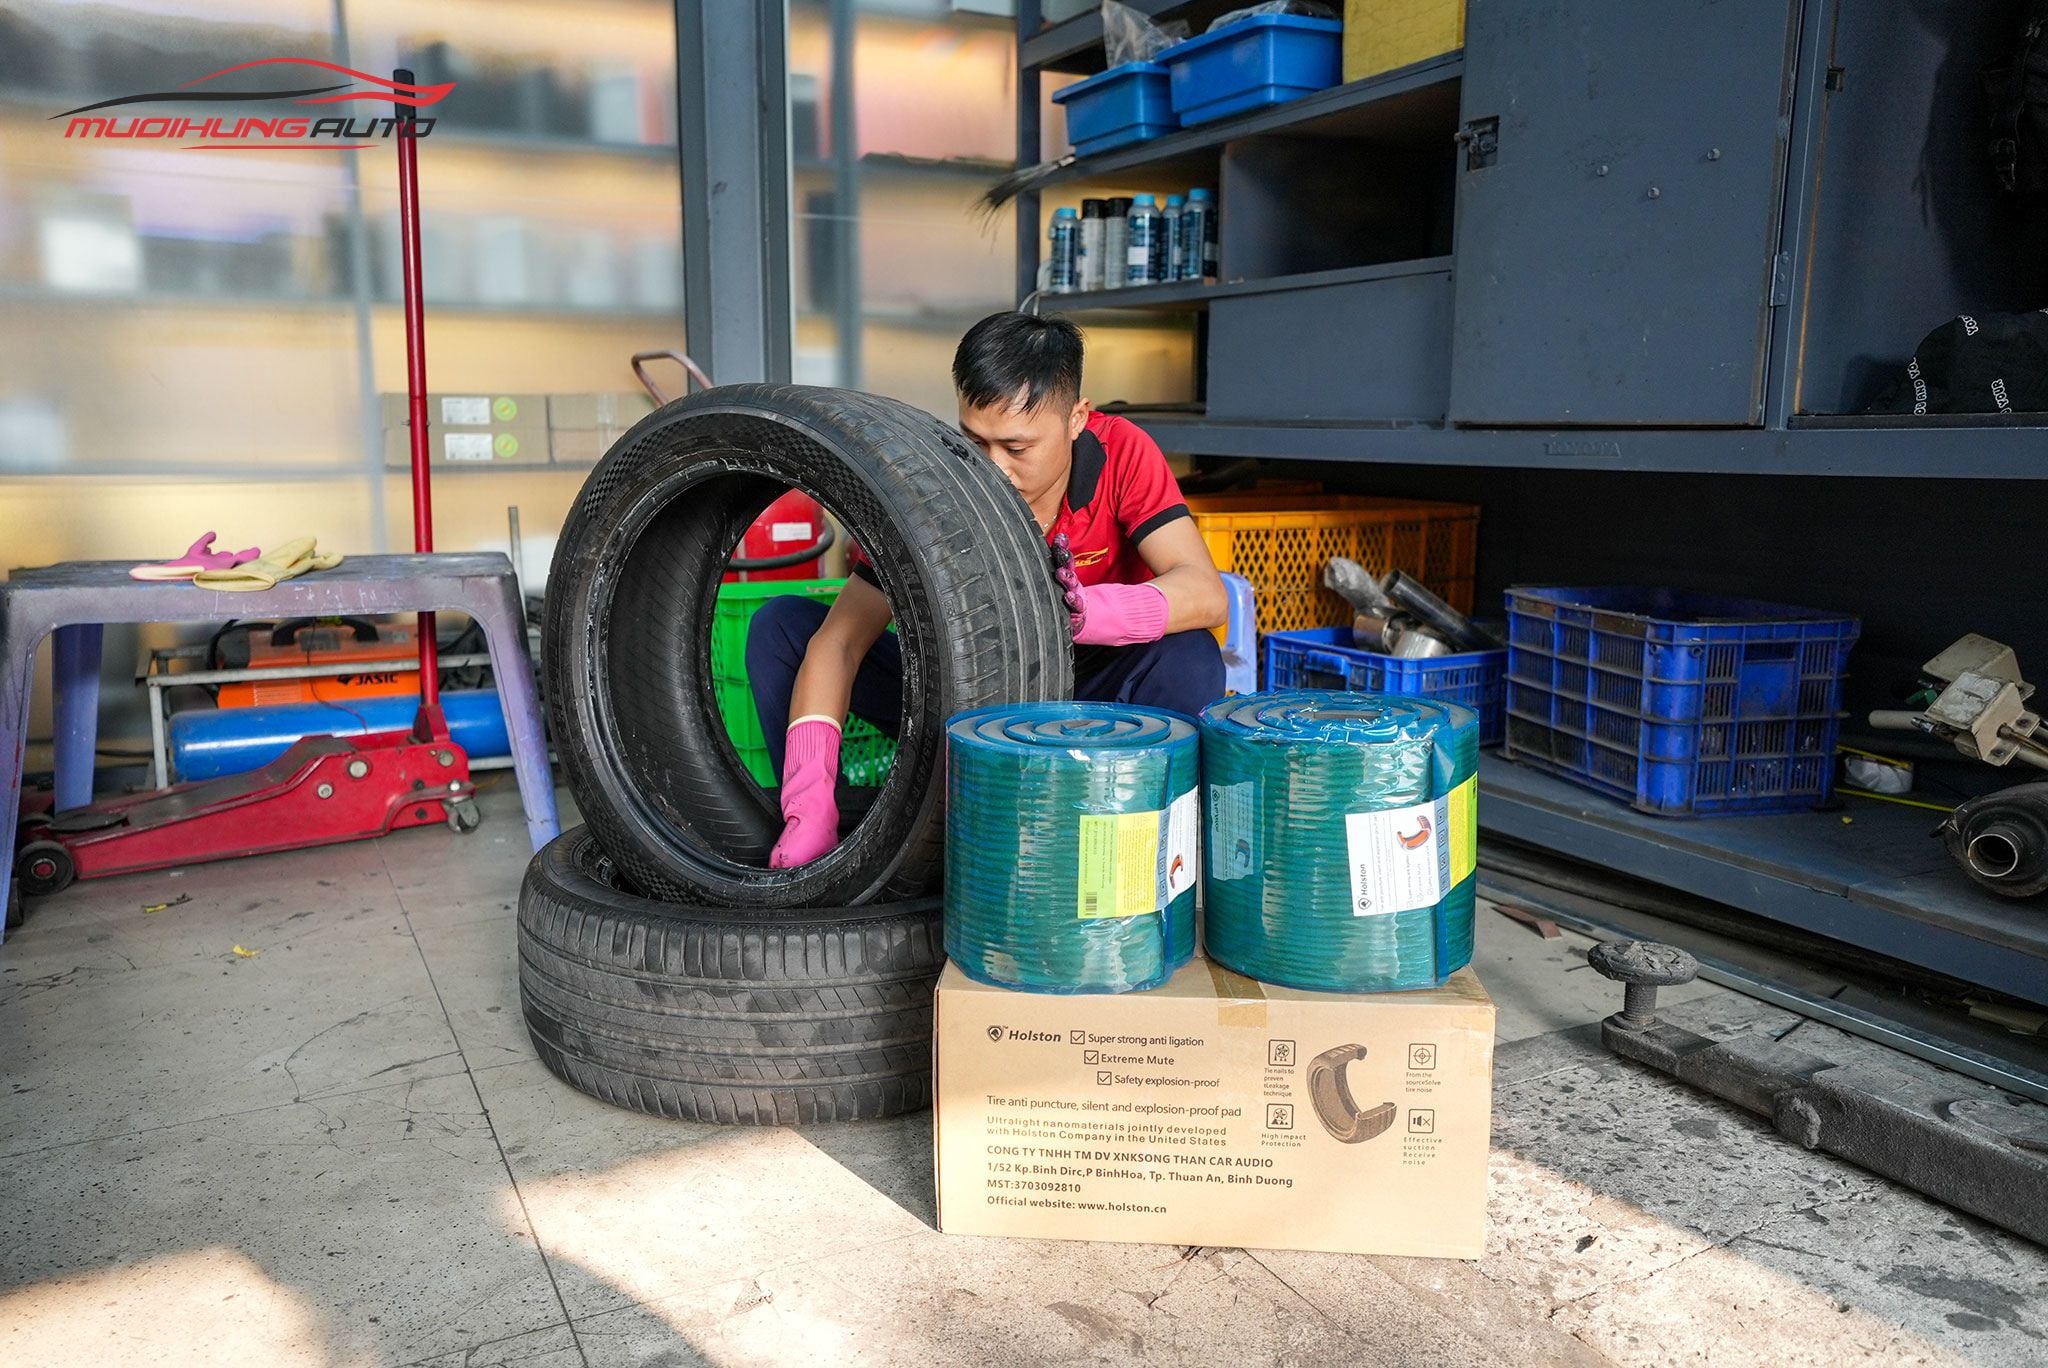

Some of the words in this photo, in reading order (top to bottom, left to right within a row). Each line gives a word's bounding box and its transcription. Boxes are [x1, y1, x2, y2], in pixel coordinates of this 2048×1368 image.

[1958, 315, 1979, 336] YOU
[1914, 379, 1927, 401] AND
[1991, 378, 2009, 409] YOUR
[355, 673, 399, 685] JASIC
[1360, 864, 1368, 895] Holston
[1008, 1030, 1062, 1042] Holston
[1088, 1033, 1116, 1048] Super
[1117, 1035, 1147, 1047] strong
[1149, 1036, 1167, 1046] anti
[1169, 1036, 1204, 1048] ligation
[1101, 1054, 1144, 1064] Extreme
[1146, 1056, 1175, 1065] Mute
[1114, 1075, 1144, 1086] Safety
[1145, 1076, 1220, 1088] explosion-proof
[987, 1095, 1006, 1106] Tire
[1008, 1096, 1028, 1107] anti
[1030, 1098, 1079, 1111] puncture,
[1082, 1099, 1109, 1112] silent
[1111, 1101, 1132, 1113] and
[1134, 1103, 1219, 1117] explosion-proof
[1221, 1106, 1241, 1118] pad
[987, 1116, 1040, 1128] Ultralight
[1043, 1119, 1125, 1131] nanomaterials
[1127, 1122, 1163, 1135] jointly
[1166, 1125, 1226, 1137] developed
[987, 1126, 1010, 1136] with
[1012, 1128, 1056, 1139] Holston
[1059, 1130, 1111, 1143] Company
[1114, 1133, 1125, 1142] in
[1128, 1133, 1145, 1144] the
[1149, 1134, 1186, 1145] United
[1189, 1136, 1226, 1147] States
[1280, 1133, 1306, 1141] impact
[1403, 1136, 1443, 1144] Effective
[987, 1145, 1019, 1157] CONG
[1022, 1147, 1036, 1157] TY
[1039, 1148, 1071, 1159] TNHH
[1074, 1150, 1092, 1160] TM
[1094, 1151, 1111, 1161] DV
[1113, 1152, 1171, 1164] XNKSONG
[1173, 1154, 1206, 1166] THAN
[1209, 1156, 1233, 1166] CAR
[1235, 1157, 1273, 1168] AUDIO
[987, 1162, 1012, 1173] 1/52
[1014, 1163, 1057, 1176] Kp.Binh
[1095, 1168, 1146, 1181] BinhHoa,
[1149, 1170, 1166, 1182] Tp.
[1168, 1171, 1203, 1183] Thuan
[1205, 1173, 1225, 1185] An,
[1227, 1174, 1252, 1185] Binh
[1255, 1175, 1293, 1188] Duong
[987, 1179, 1081, 1193] MST:3703092810
[987, 1195, 1027, 1207] Official
[1029, 1197, 1076, 1209] website:
[1077, 1200, 1167, 1214] www.holston.cn
